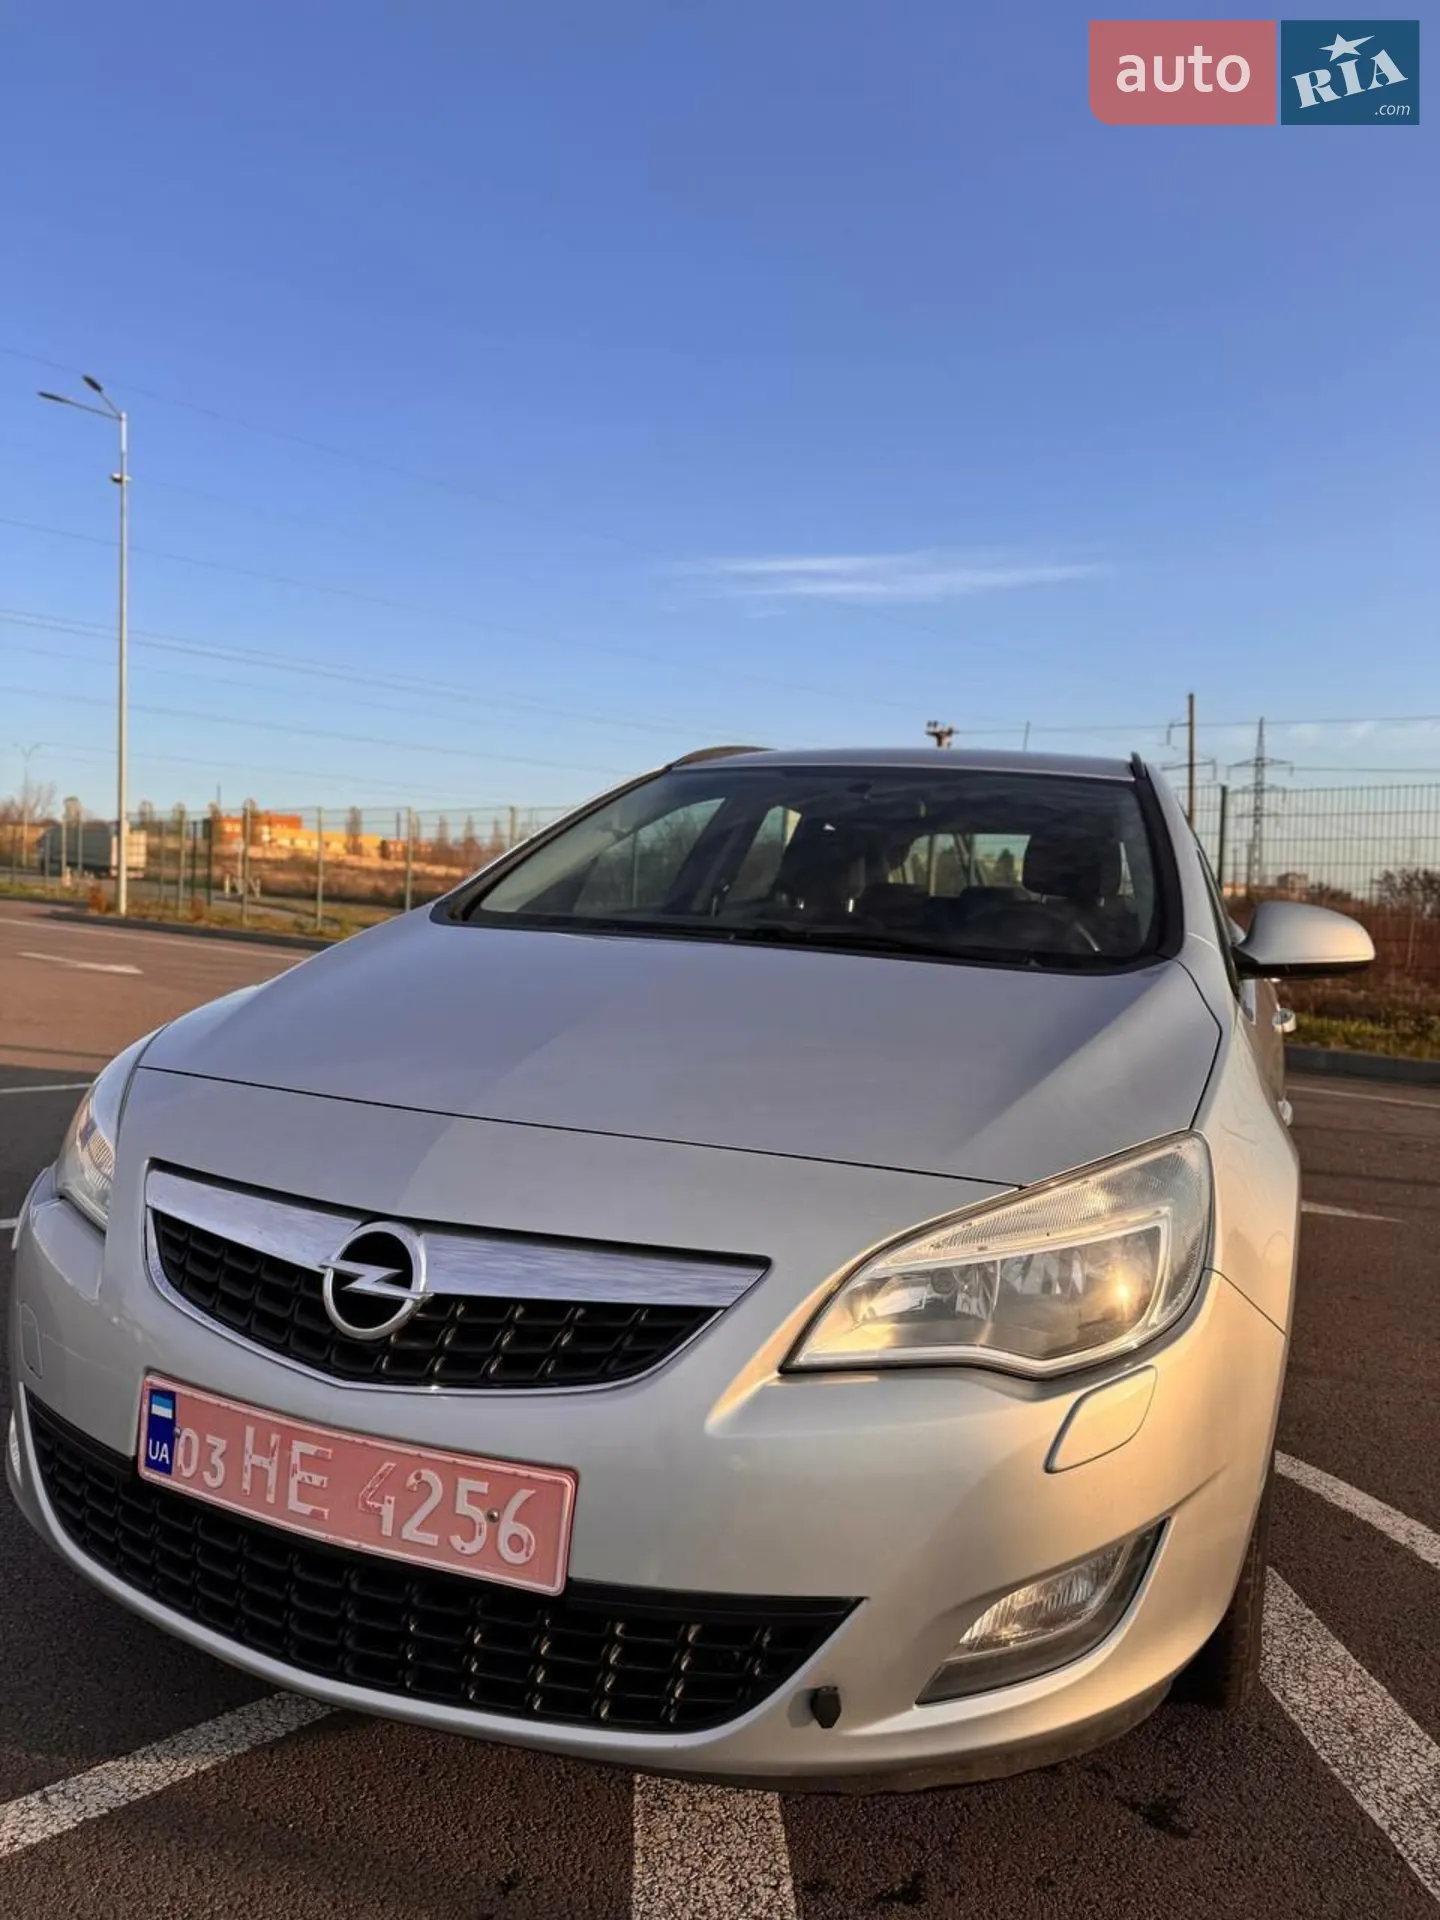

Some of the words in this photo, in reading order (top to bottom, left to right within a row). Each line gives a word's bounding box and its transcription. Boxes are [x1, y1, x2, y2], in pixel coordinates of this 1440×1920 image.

[149, 1438, 170, 1465] UA
[177, 1427, 228, 1489] 03
[242, 1426, 333, 1521] HE
[358, 1461, 537, 1566] 4256
